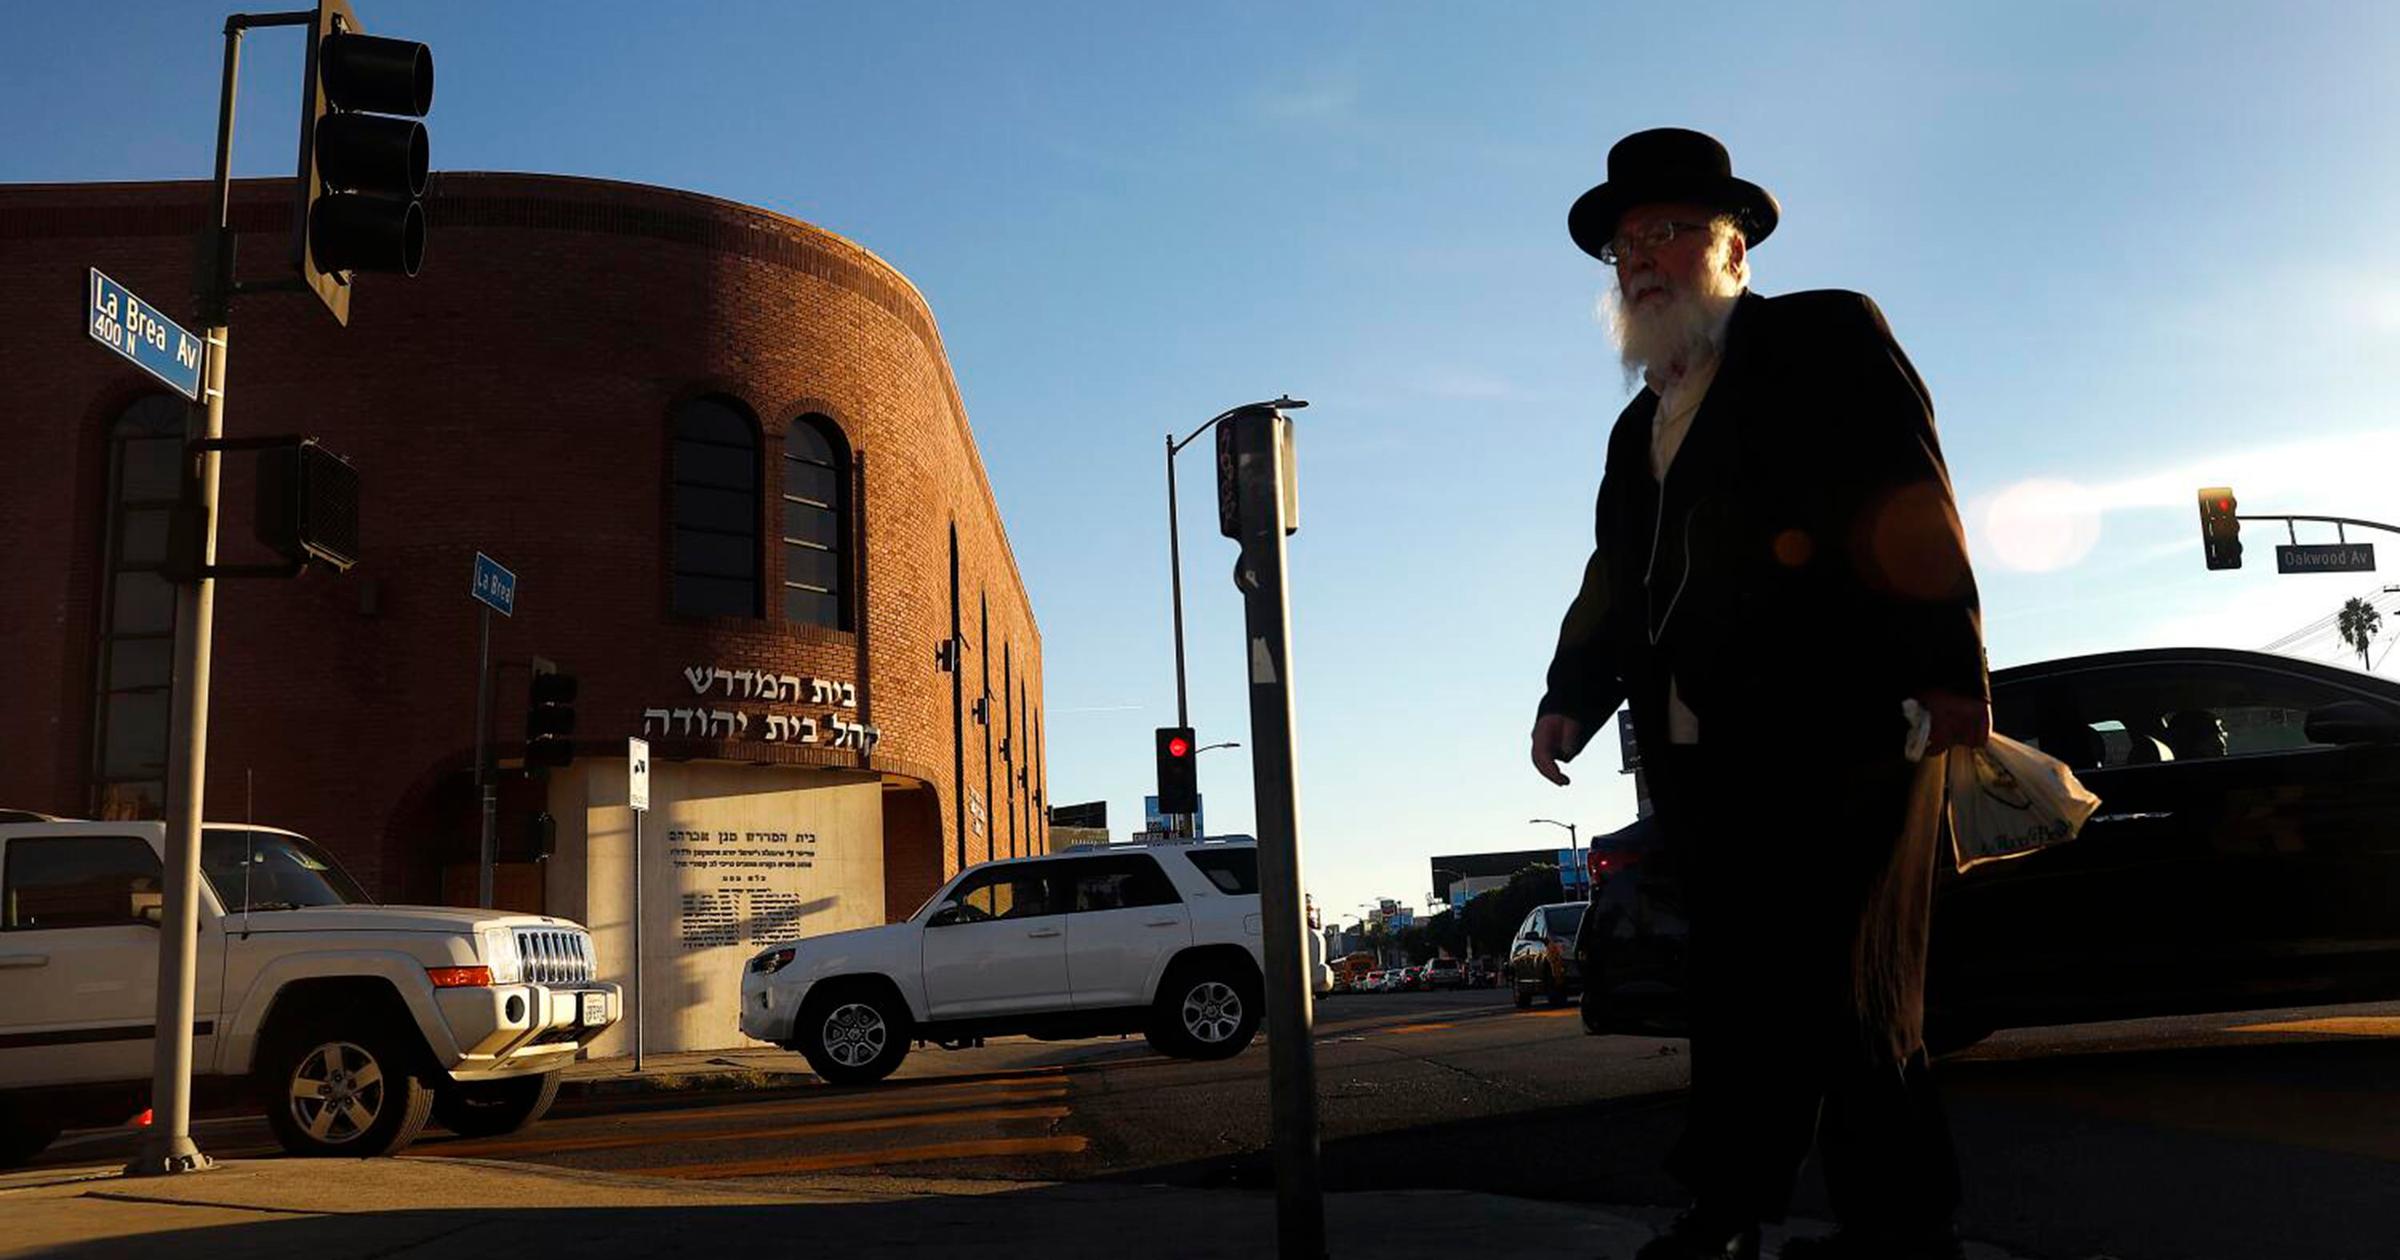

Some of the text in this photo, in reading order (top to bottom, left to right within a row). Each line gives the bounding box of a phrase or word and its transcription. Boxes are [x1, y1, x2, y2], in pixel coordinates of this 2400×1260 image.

[95, 277, 197, 369] La Brea Av
[95, 314, 136, 356] 400 N
[2284, 551, 2368, 567] Oakwood Av
[477, 566, 511, 604] La Brea
[684, 666, 857, 708] בית המדרש
[644, 707, 881, 757] קהל בית יהודה
[795, 832, 816, 843] בית
